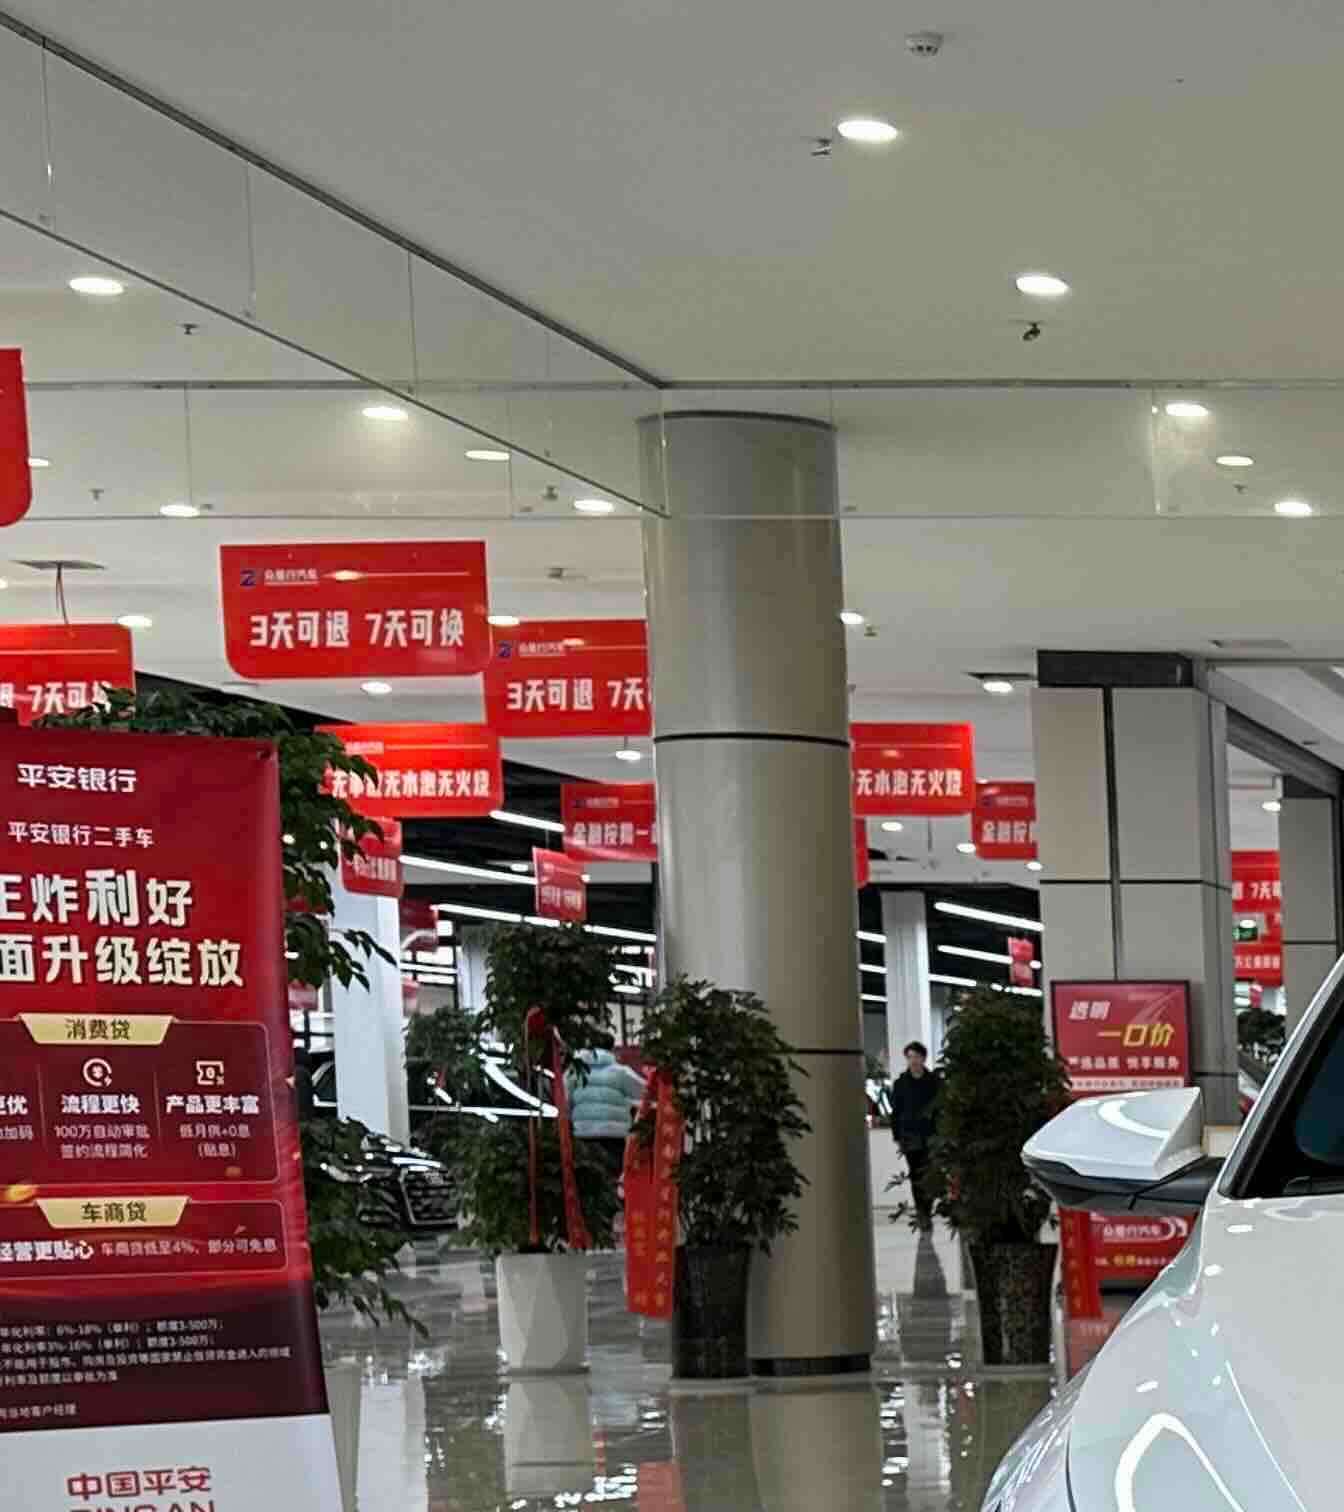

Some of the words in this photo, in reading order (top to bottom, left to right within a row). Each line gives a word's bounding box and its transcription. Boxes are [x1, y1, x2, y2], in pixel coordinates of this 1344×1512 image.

[250, 610, 349, 649] 3天可退
[365, 607, 464, 648] 7天可换
[506, 678, 593, 712] 3天可退
[607, 677, 651, 711] 7天
[17, 763, 137, 793] 平安银行
[851, 769, 962, 796] 无水泡无火烧
[8, 821, 154, 848] 平安银行二手车
[0, 933, 244, 988] 面升级绽放
[65, 1018, 131, 1041] 消费贷
[1096, 1023, 1175, 1049] 一口价
[61, 1094, 141, 1114] 流程更快
[166, 1095, 260, 1114] 产品更丰富
[81, 1201, 147, 1224] 车商贷
[67, 1467, 212, 1501] 中国平安
